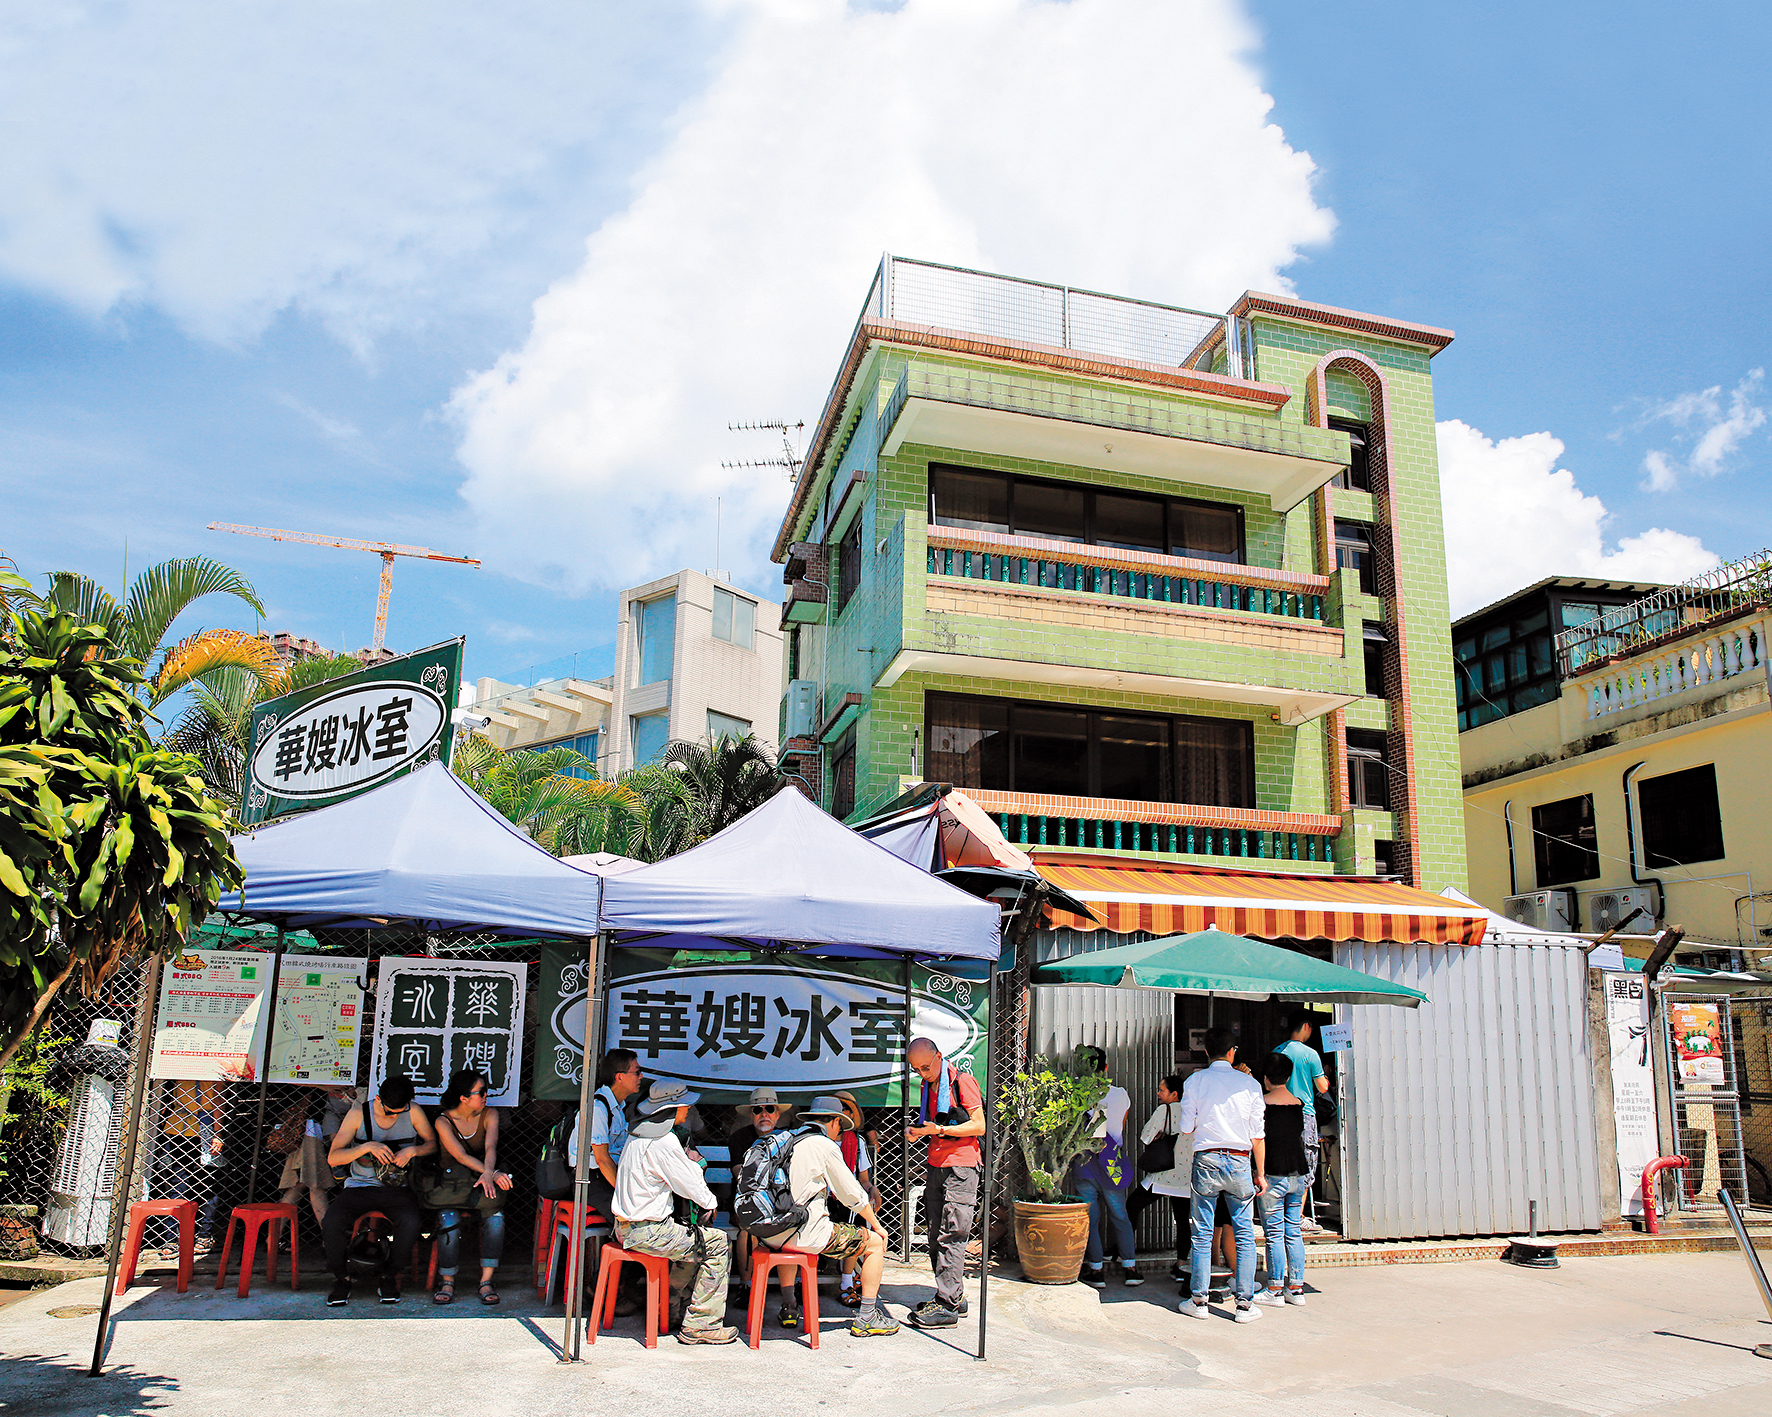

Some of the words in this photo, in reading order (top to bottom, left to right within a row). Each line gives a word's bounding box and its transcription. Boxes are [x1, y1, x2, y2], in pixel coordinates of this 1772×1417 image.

[273, 696, 413, 782] 華嫂冰室
[1614, 980, 1643, 999] 黑白
[619, 989, 907, 1061] 華嫂冰室
[1646, 1172, 1656, 1209] 903
